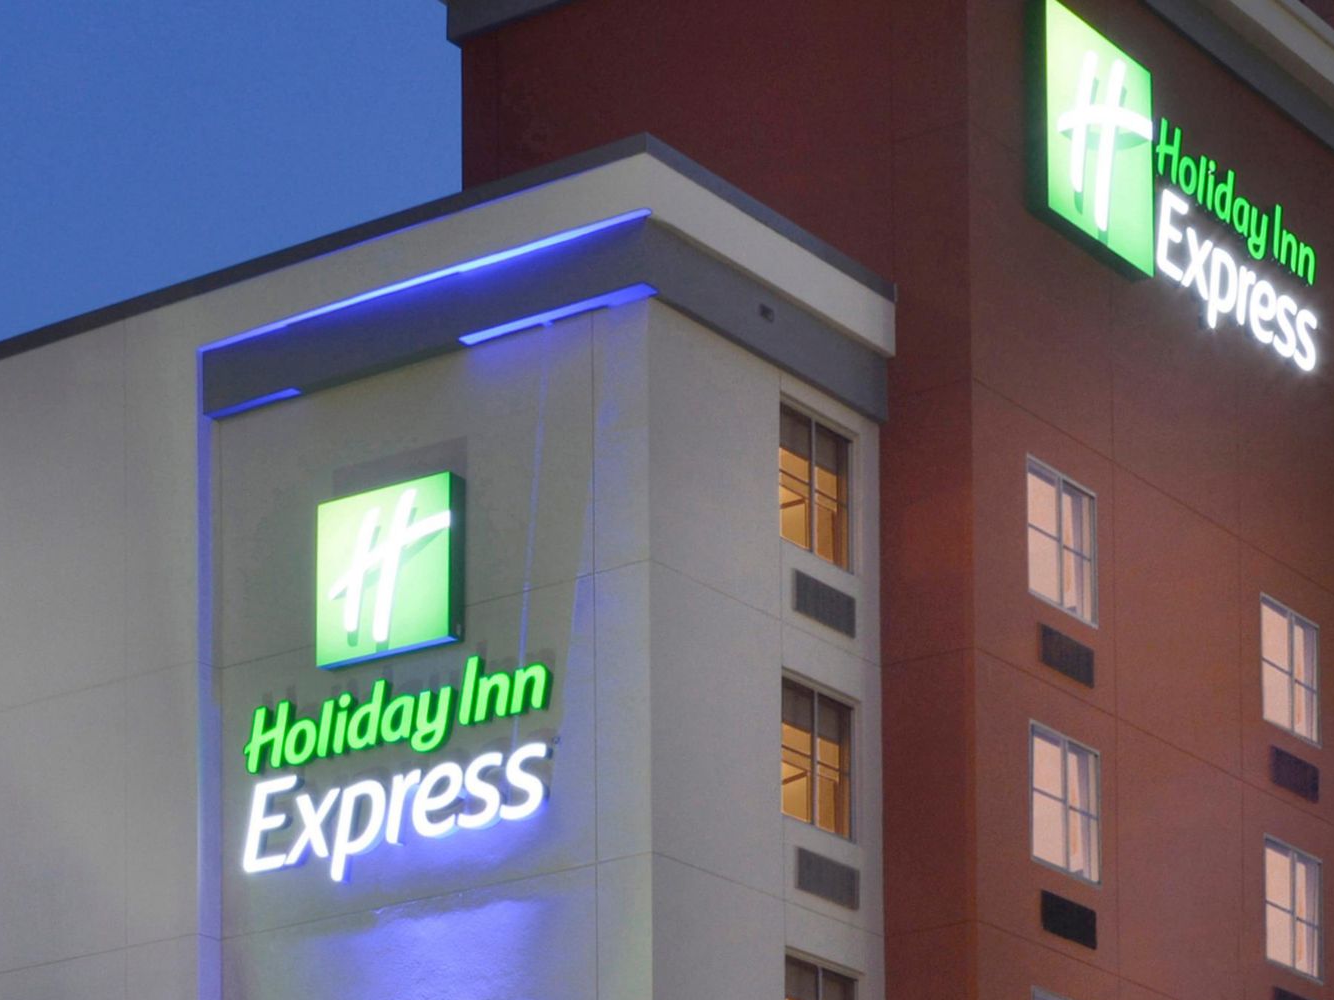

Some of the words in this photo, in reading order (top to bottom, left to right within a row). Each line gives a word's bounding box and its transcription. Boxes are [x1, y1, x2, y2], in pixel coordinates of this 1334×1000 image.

[1156, 117, 1269, 261] Holiday
[1273, 203, 1317, 286] Inn
[1155, 188, 1318, 372] Express
[244, 679, 454, 773] Holiday
[458, 655, 552, 726] Inn
[242, 742, 550, 882] Express
